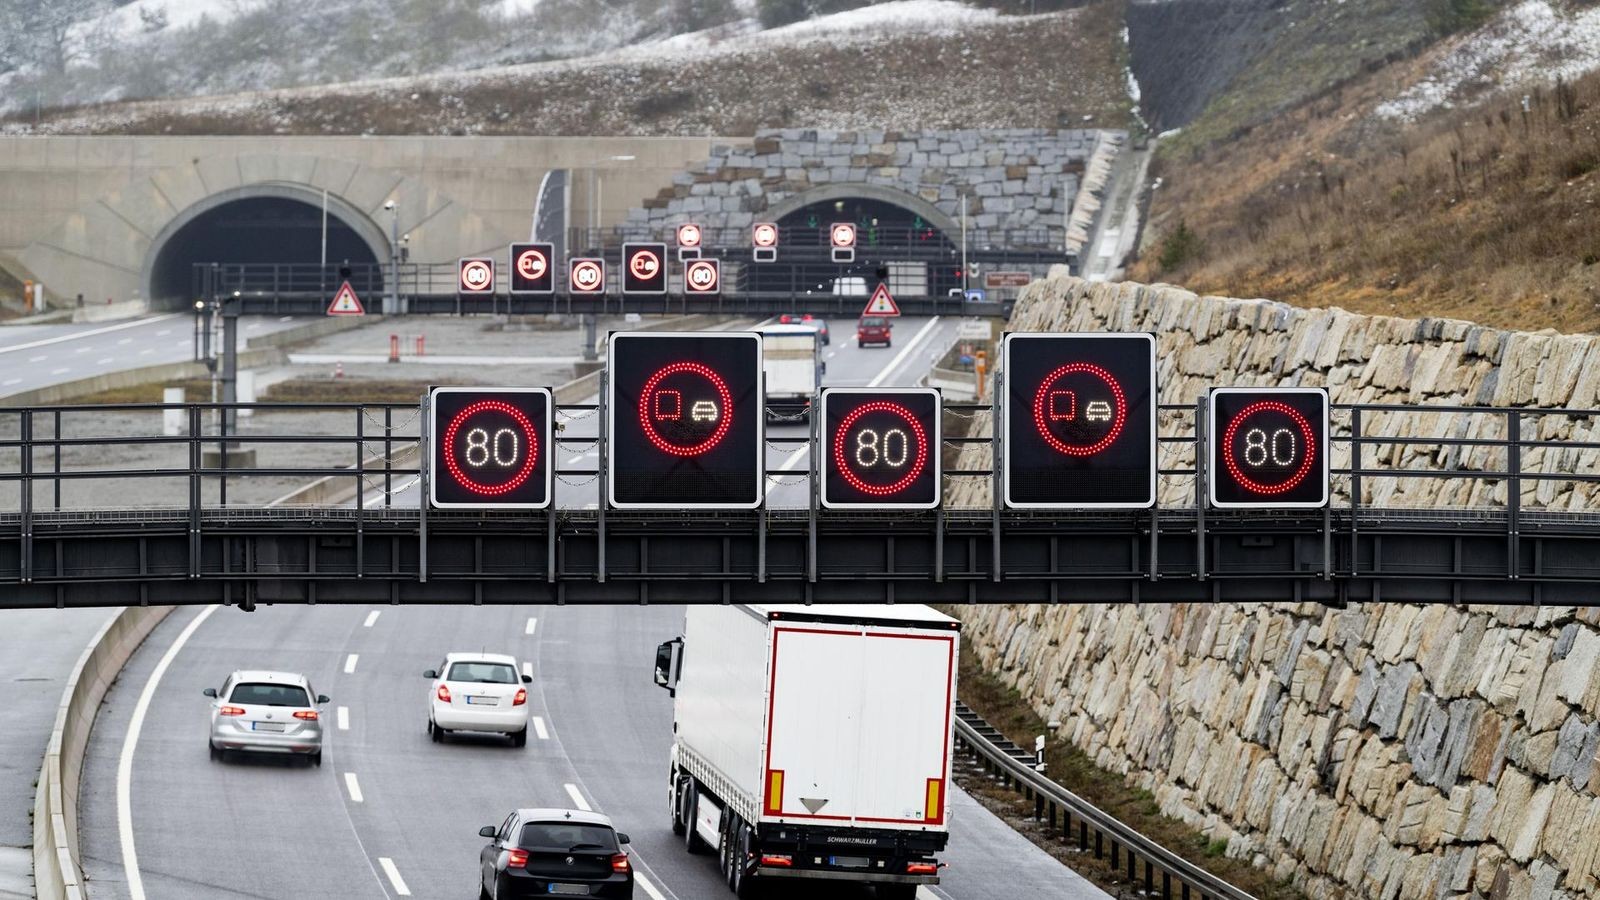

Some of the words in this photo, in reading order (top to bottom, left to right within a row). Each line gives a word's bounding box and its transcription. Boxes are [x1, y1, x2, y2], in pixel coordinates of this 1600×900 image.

[466, 428, 518, 466] 80
[857, 429, 907, 467] 80
[1245, 428, 1295, 466] 80
